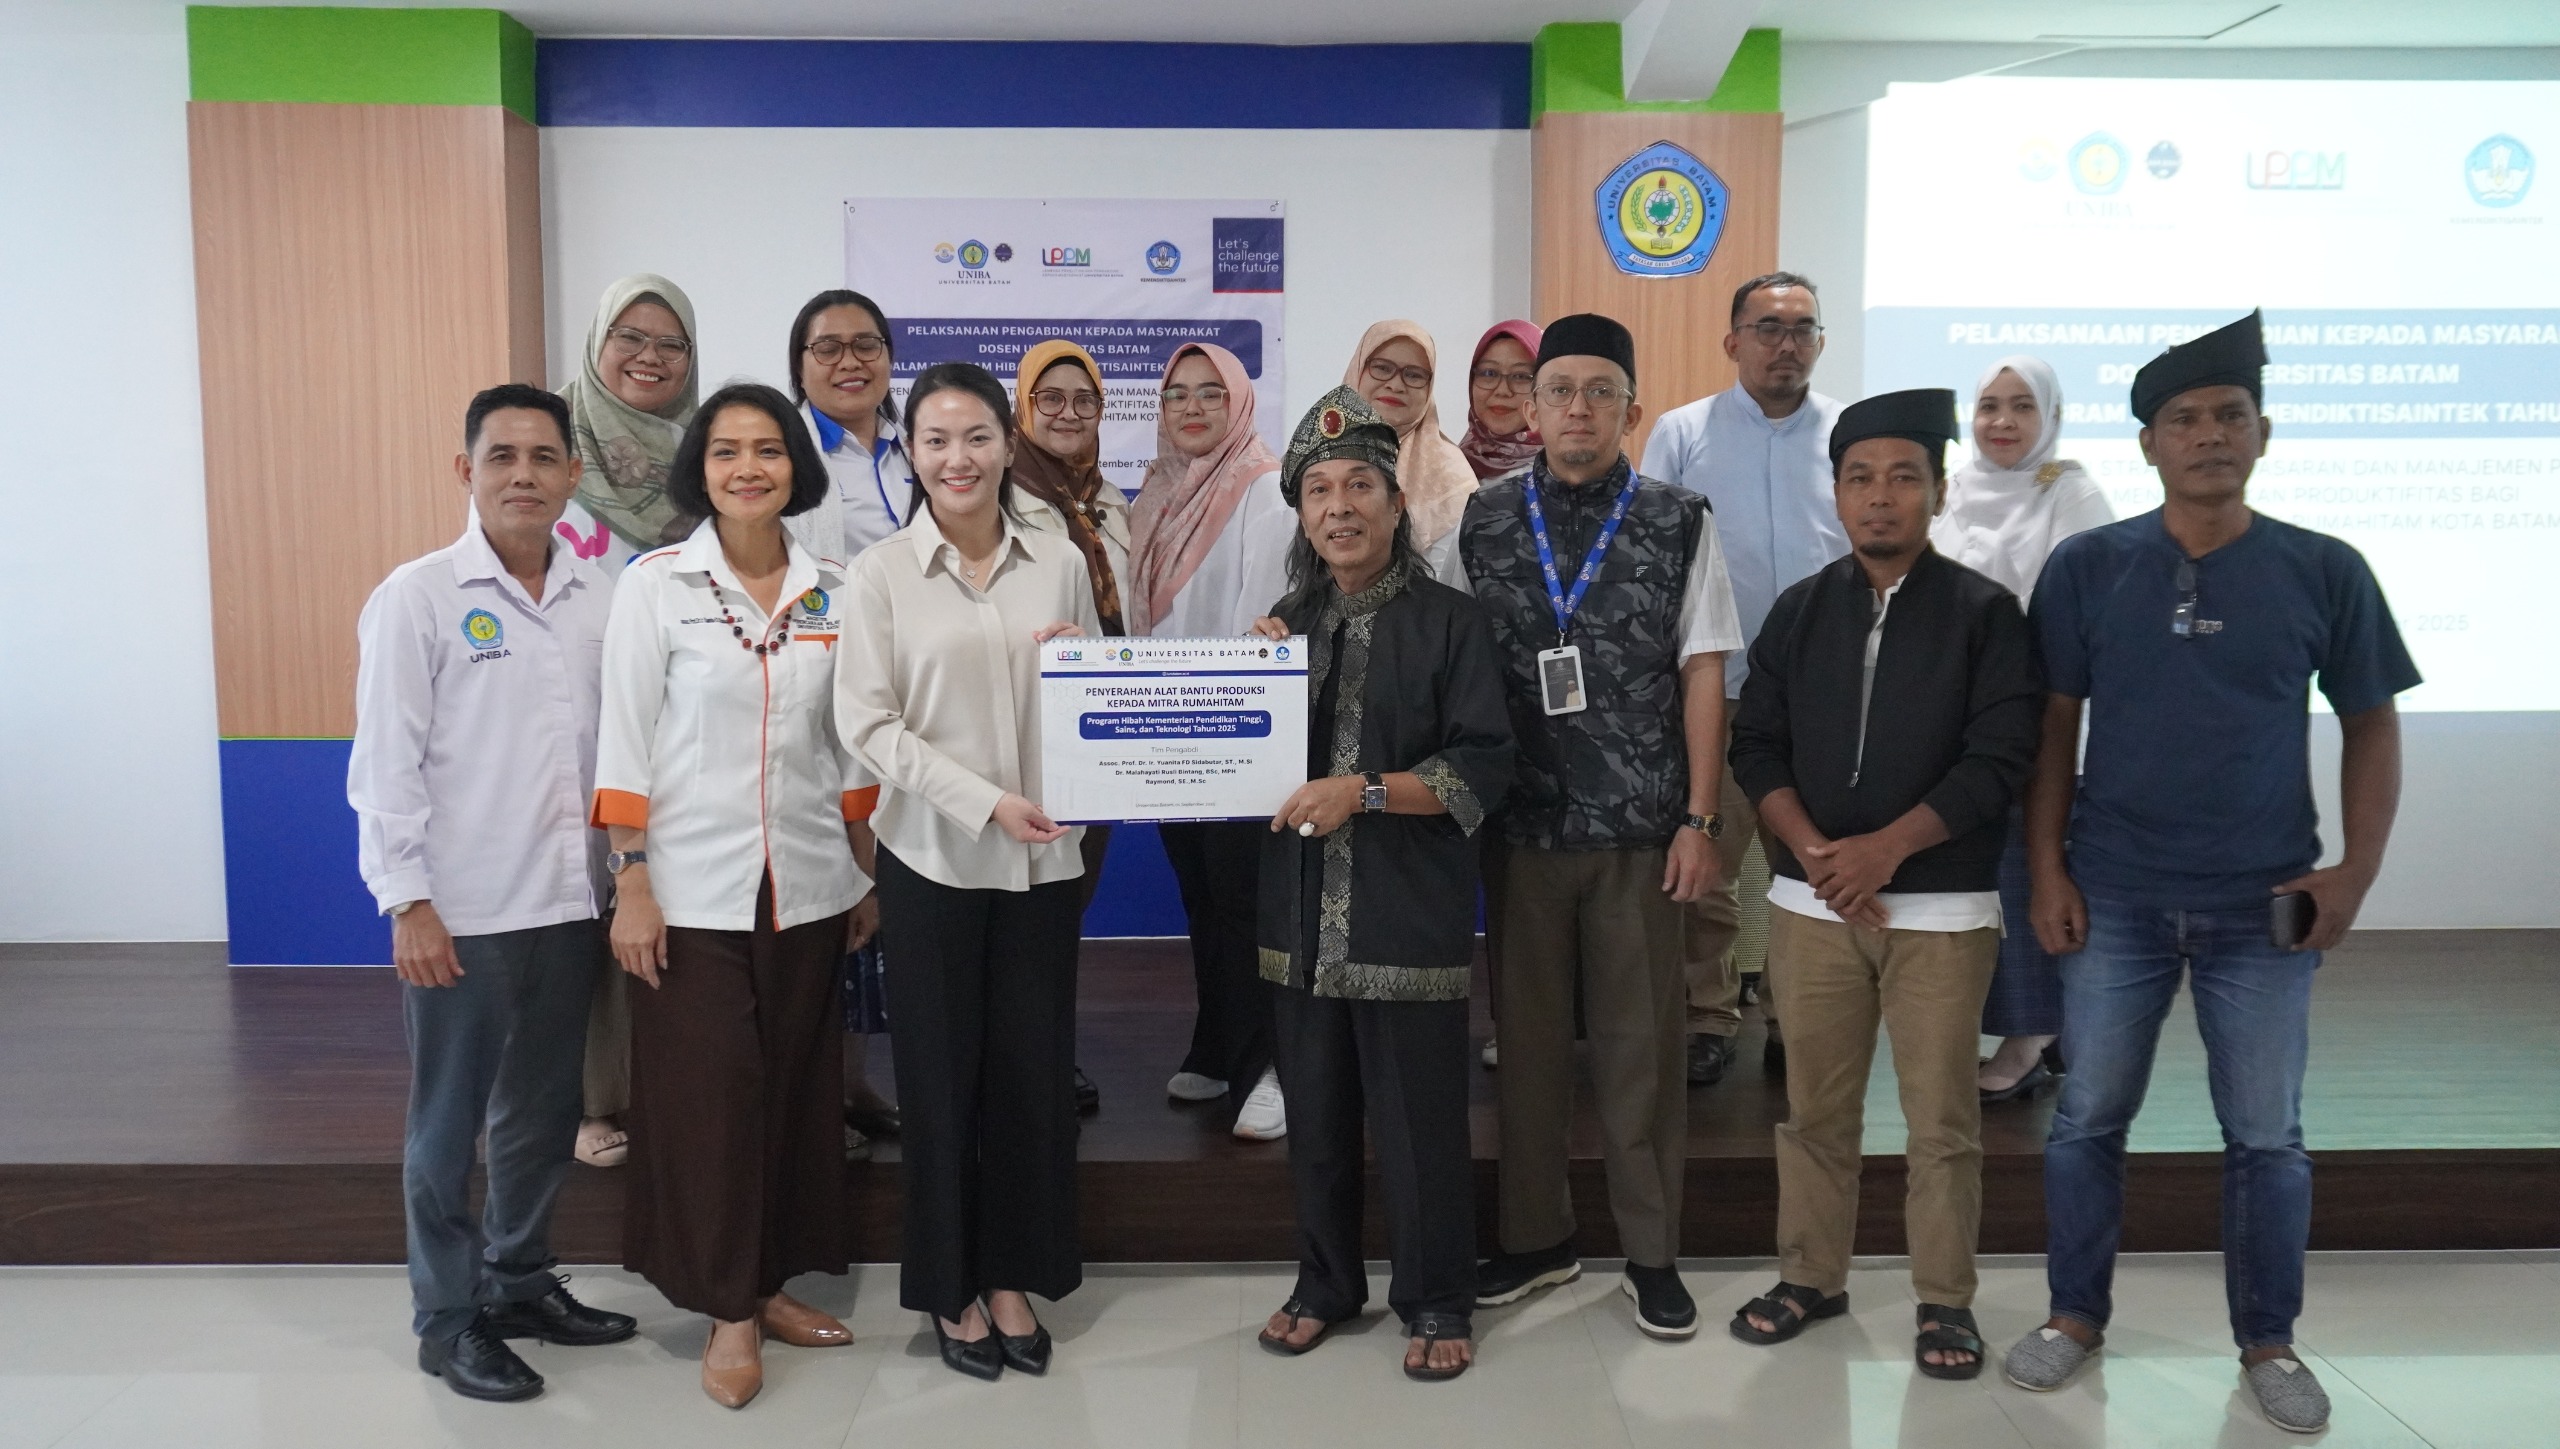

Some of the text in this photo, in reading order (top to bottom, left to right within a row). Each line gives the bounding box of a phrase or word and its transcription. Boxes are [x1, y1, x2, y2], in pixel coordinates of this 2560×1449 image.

[2246, 150, 2347, 191] LPPM
[1608, 156, 1718, 209] UNIVERSITAS BATAM
[1218, 238, 1249, 249] Let's
[1042, 247, 1090, 267] LPPM
[1218, 250, 1279, 263] challenge
[1218, 262, 1279, 273] the future
[958, 270, 991, 279] UNIBA
[907, 326, 1221, 337] PELAKSANAAN PENGABDIAN KEPADA MASYARAKAT
[1949, 323, 2144, 344] PELAKSANAAN
[2323, 325, 2427, 345] KEPADA
[2432, 325, 2560, 345] MASYARA
[979, 344, 1021, 354] DOSEN
[1108, 345, 1150, 354] BATAM
[892, 362, 928, 371] ALAM
[995, 362, 1018, 371] HIB
[2261, 364, 2460, 384] ERSITAS BATAM
[1103, 400, 1156, 409] UKTIFITAS
[1140, 413, 1159, 421] KOT
[1098, 459, 1134, 468] tember
[2259, 459, 2346, 476] ASARAN
[2351, 459, 2399, 476] DAN
[2404, 458, 2543, 476] MANAJEMEN
[2294, 486, 2463, 503] PRODUKTIFITAS
[2470, 485, 2520, 503] BAGI
[2430, 513, 2485, 530] KOTA
[2492, 513, 2560, 530] BATAM
[1583, 561, 1592, 573] NUS
[2416, 614, 2470, 631] 2025
[470, 649, 512, 663] UNIBA
[1085, 686, 1265, 696] PENYERAHAN ALAT BANTU PRODUKSI
[1107, 698, 1244, 708] KEPADA MITRA RUMAHITAM
[1087, 715, 1264, 726] Program Hibah Kementerian Pendidikan Tinggi,
[1115, 726, 1138, 735] Sains,
[1155, 725, 1192, 734] Teknologi
[1193, 725, 1216, 733] Tahun
[1165, 746, 1199, 755] Pengabdi
